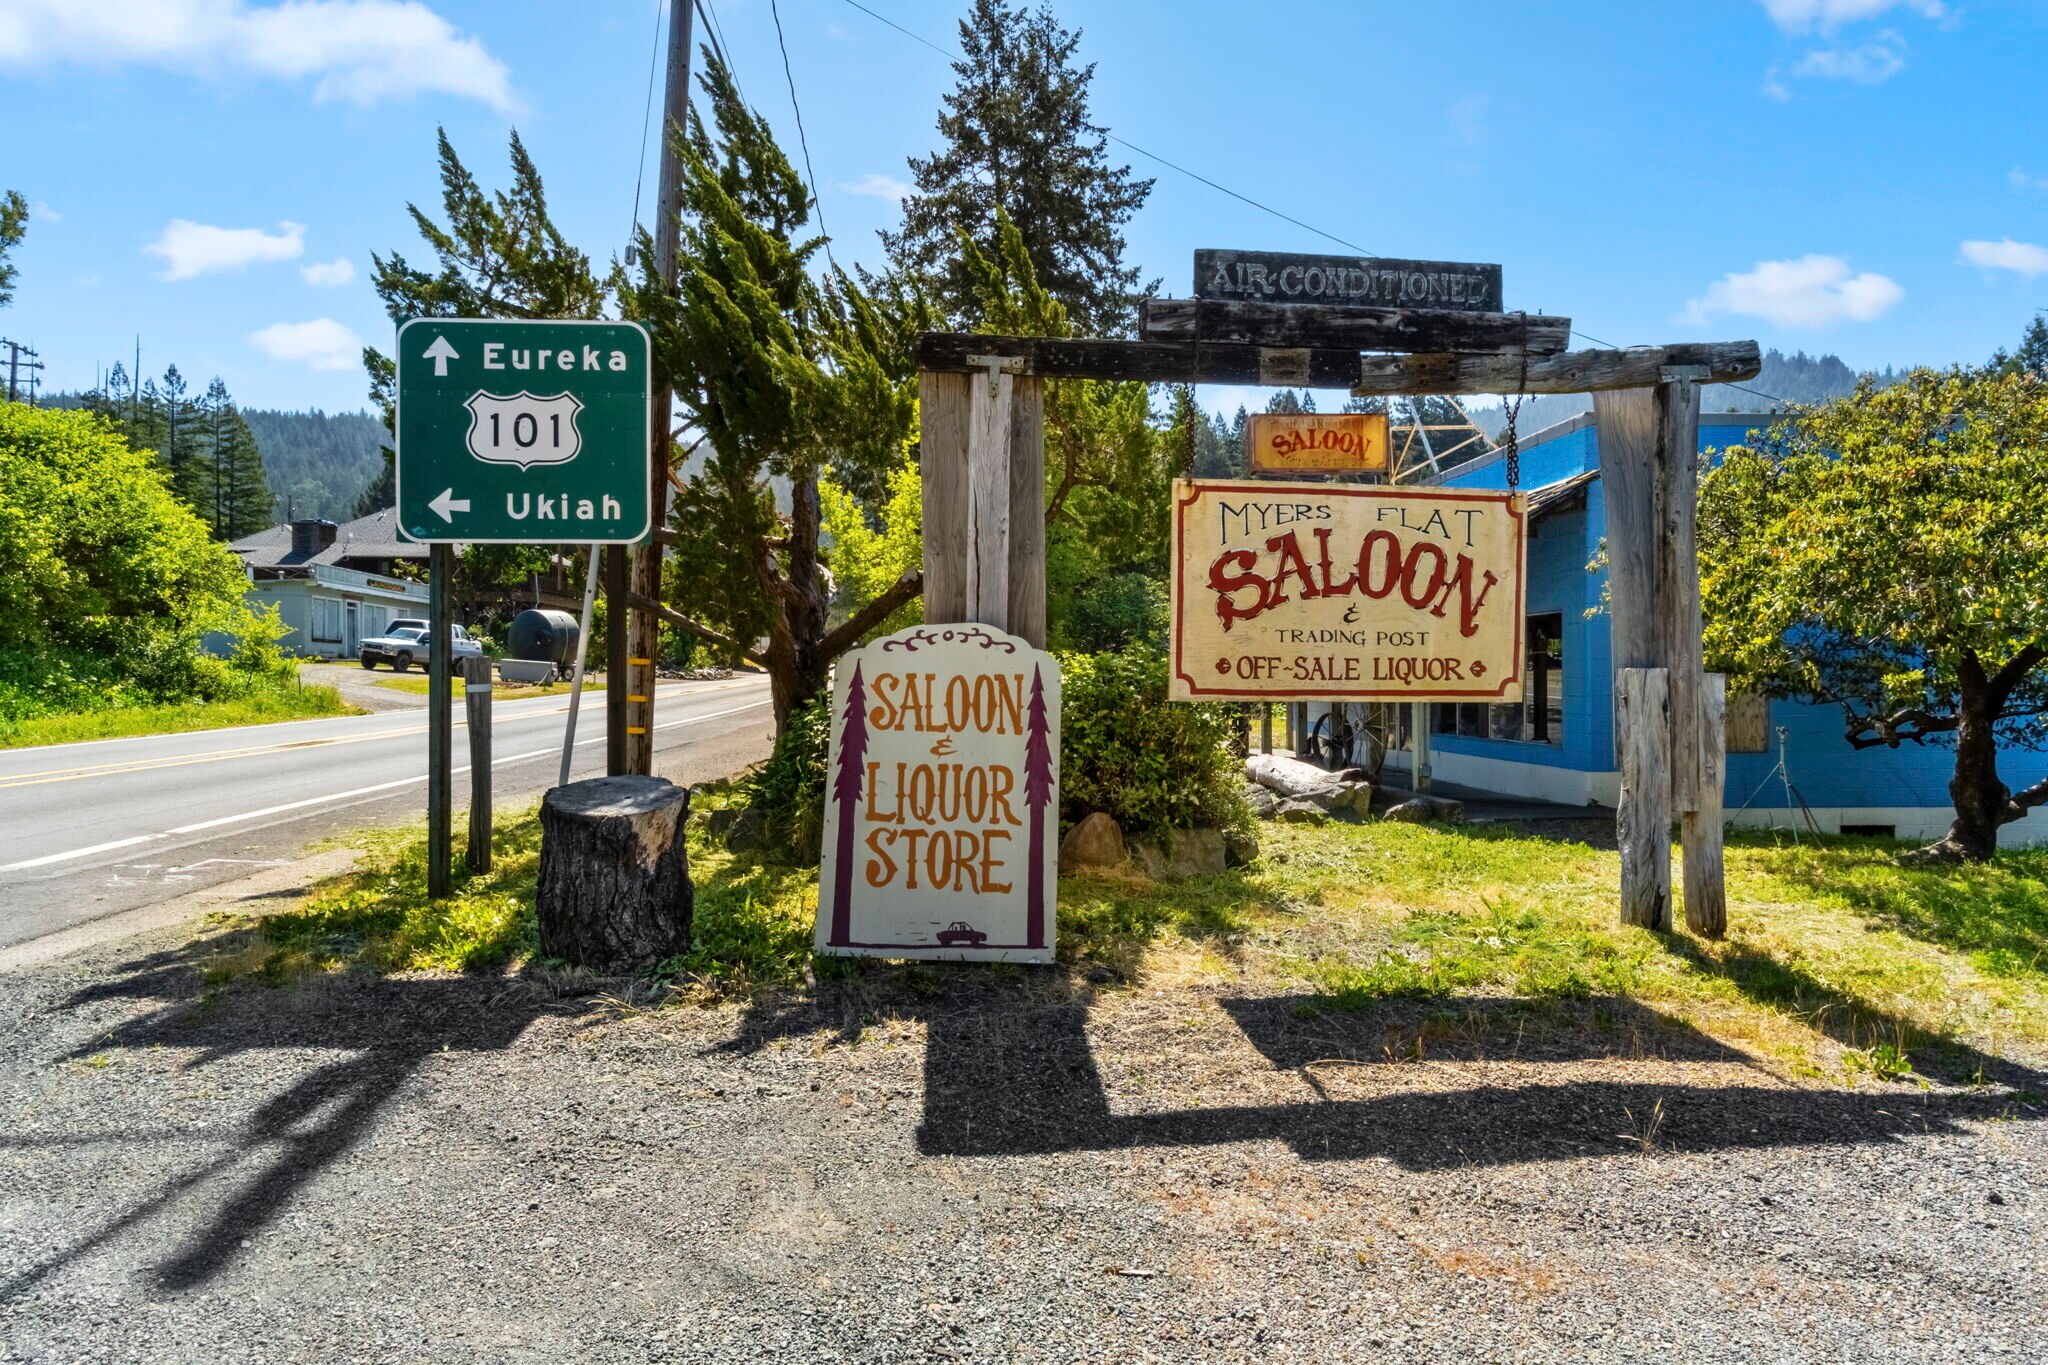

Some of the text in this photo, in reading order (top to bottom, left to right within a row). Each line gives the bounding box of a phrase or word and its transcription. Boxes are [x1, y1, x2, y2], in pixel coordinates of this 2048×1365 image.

[483, 342, 627, 372] Eureka
[490, 412, 560, 448] 101
[1271, 428, 1372, 461] SALOON
[506, 493, 622, 520] Ukiah
[1218, 501, 1484, 548] MYERS FLAT
[1206, 527, 1499, 638] SALOON
[1342, 602, 1361, 624] &
[1275, 629, 1430, 647] TRADING POST
[1372, 657, 1465, 686] LIQUOR
[869, 672, 1025, 736] SALOON
[929, 734, 957, 759] &
[865, 761, 1023, 826] LIQUOR
[864, 827, 1014, 895] STORE
